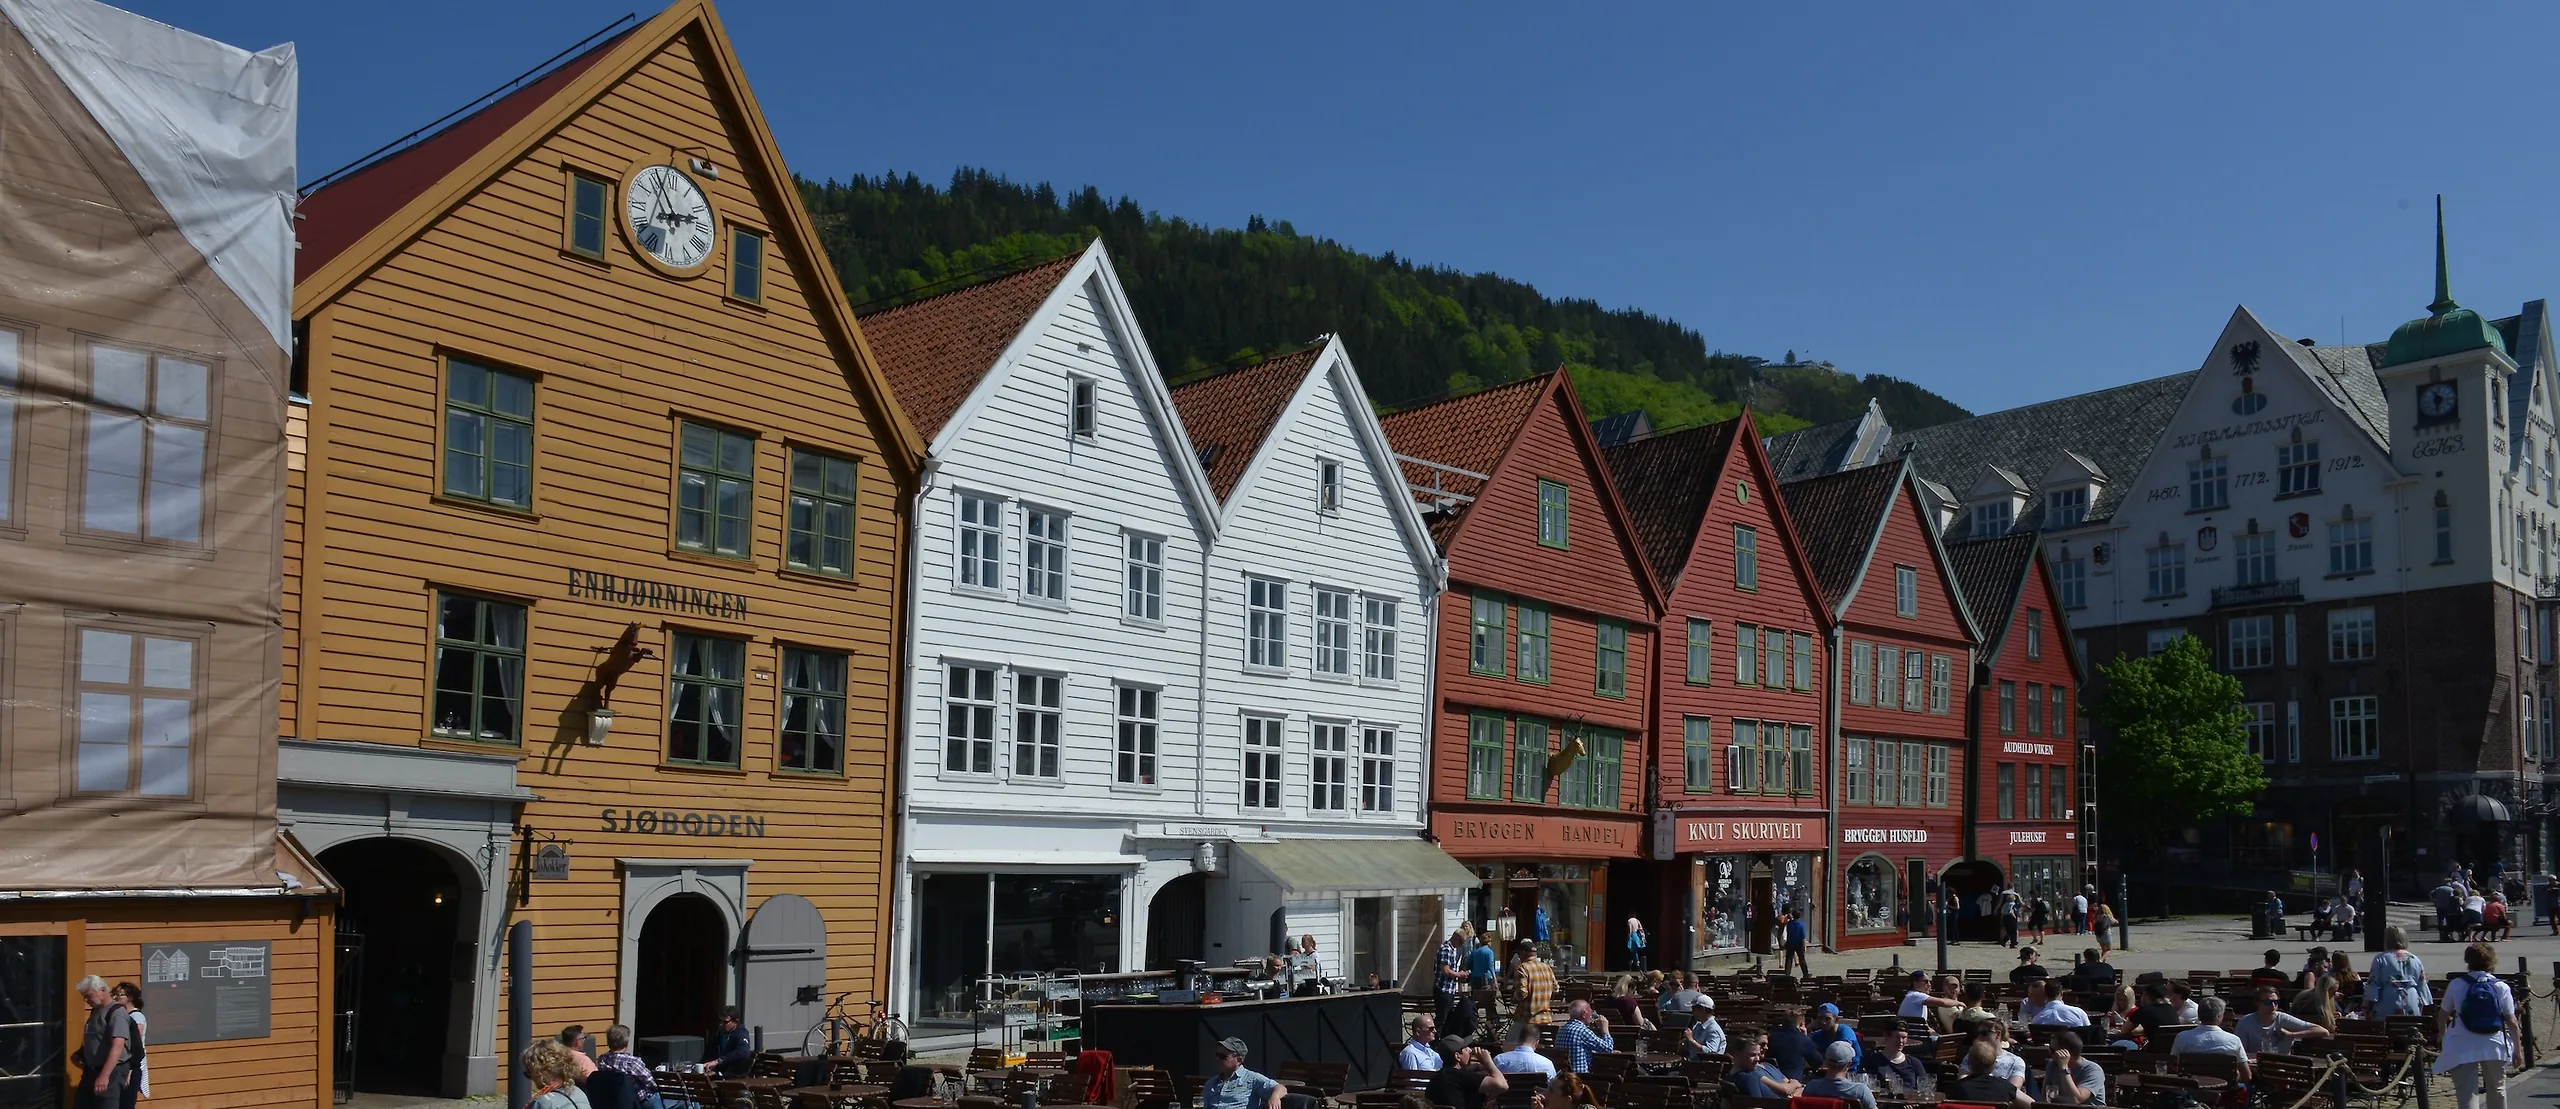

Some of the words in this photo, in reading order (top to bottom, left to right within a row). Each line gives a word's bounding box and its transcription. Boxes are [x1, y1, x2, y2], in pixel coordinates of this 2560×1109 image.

[2328, 455, 2364, 473] 1912.
[2234, 471, 2270, 488] 1712.
[2147, 486, 2181, 503] 1480.
[568, 568, 747, 622] ENHJØRNINGEN
[2003, 741, 2033, 754] AUDHILD
[2034, 743, 2054, 756] VIKEN
[601, 808, 765, 838] SJØBODEN
[1688, 822, 1724, 841] KNUT
[1732, 822, 1802, 841] SKURTVEIT
[1453, 820, 1535, 841] BRYGGEN
[1562, 825, 1621, 845] HANDEL
[1844, 828, 1887, 843] BRYGGEN
[1889, 829, 1928, 843] HUSFLID
[2010, 831, 2047, 846] JULEHUSET
